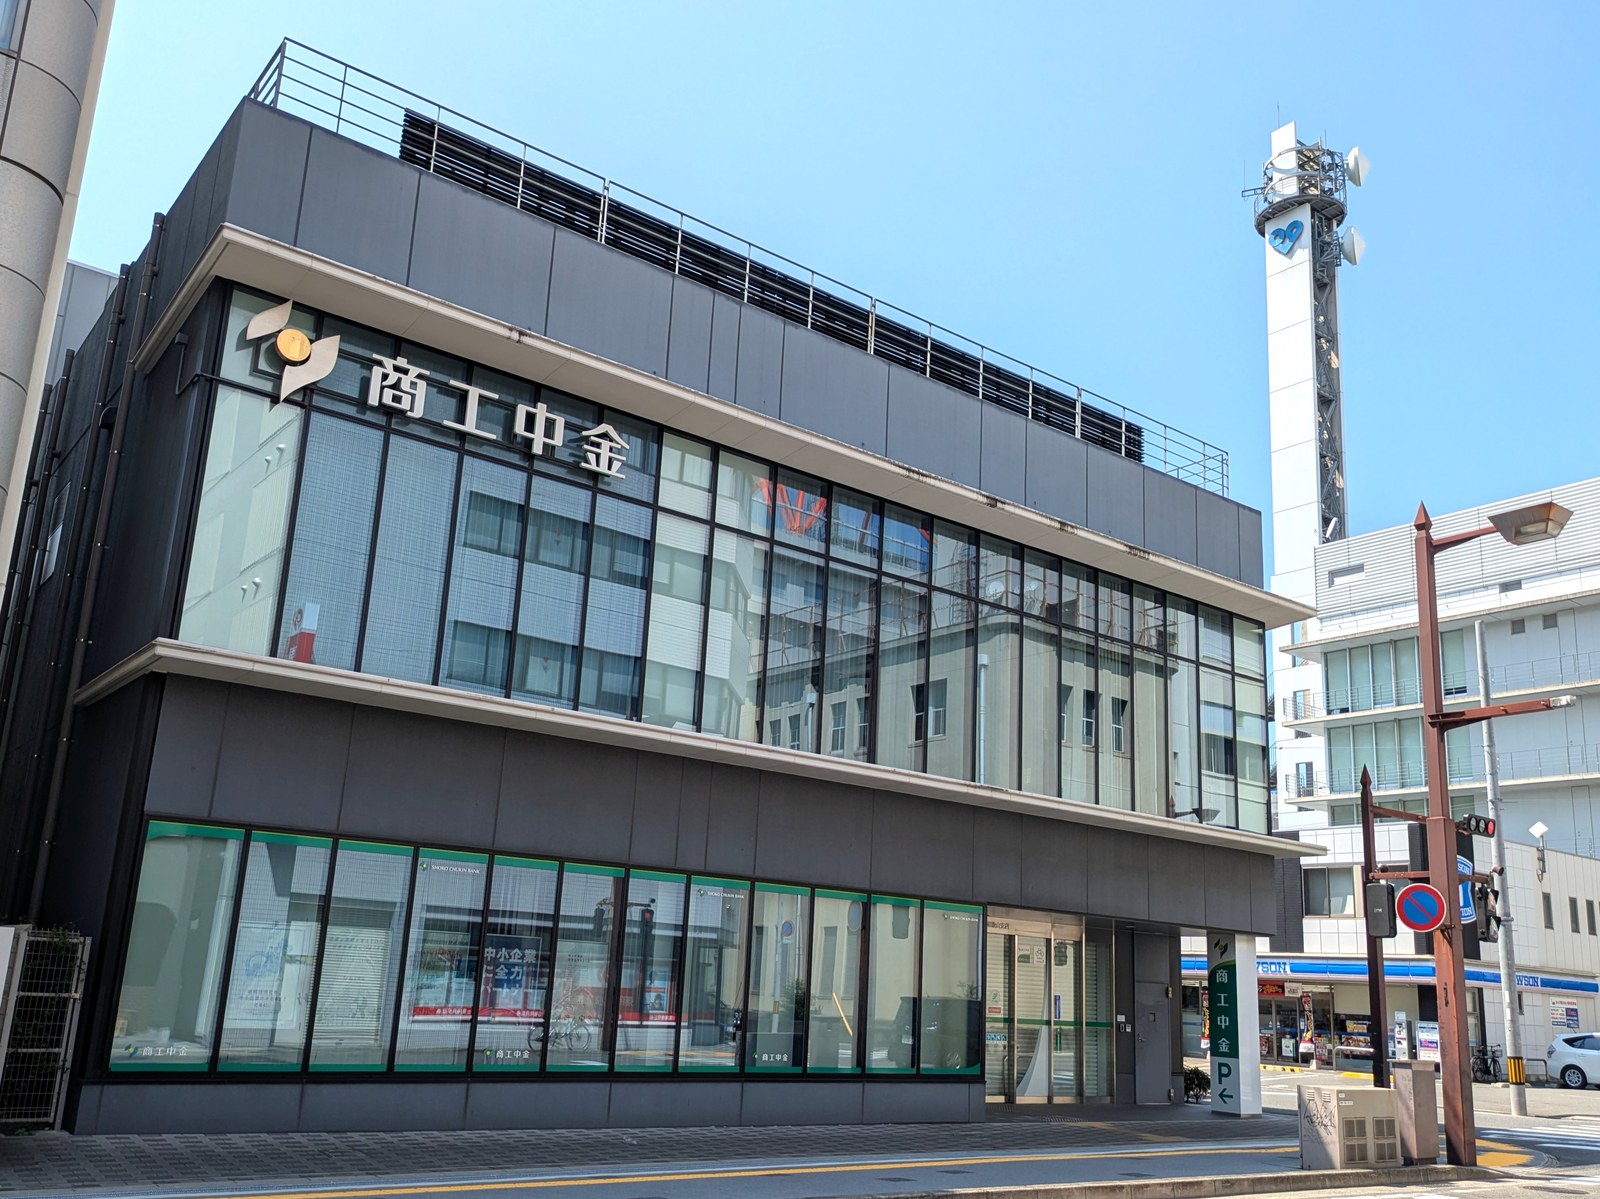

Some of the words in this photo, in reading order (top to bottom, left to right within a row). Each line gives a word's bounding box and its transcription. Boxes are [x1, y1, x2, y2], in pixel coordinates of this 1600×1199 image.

[366, 352, 630, 479] 商工中金
[431, 864, 449, 872] SHOKO
[484, 946, 537, 963] 中小企業
[483, 964, 523, 980] に全力
[1516, 974, 1539, 987] WSON
[1216, 968, 1230, 1053] 商工中金
[142, 1046, 188, 1056] 商工中金
[496, 1049, 531, 1059] 商工中金
[761, 1053, 789, 1061] 商工中金
[1217, 1062, 1232, 1085] P
